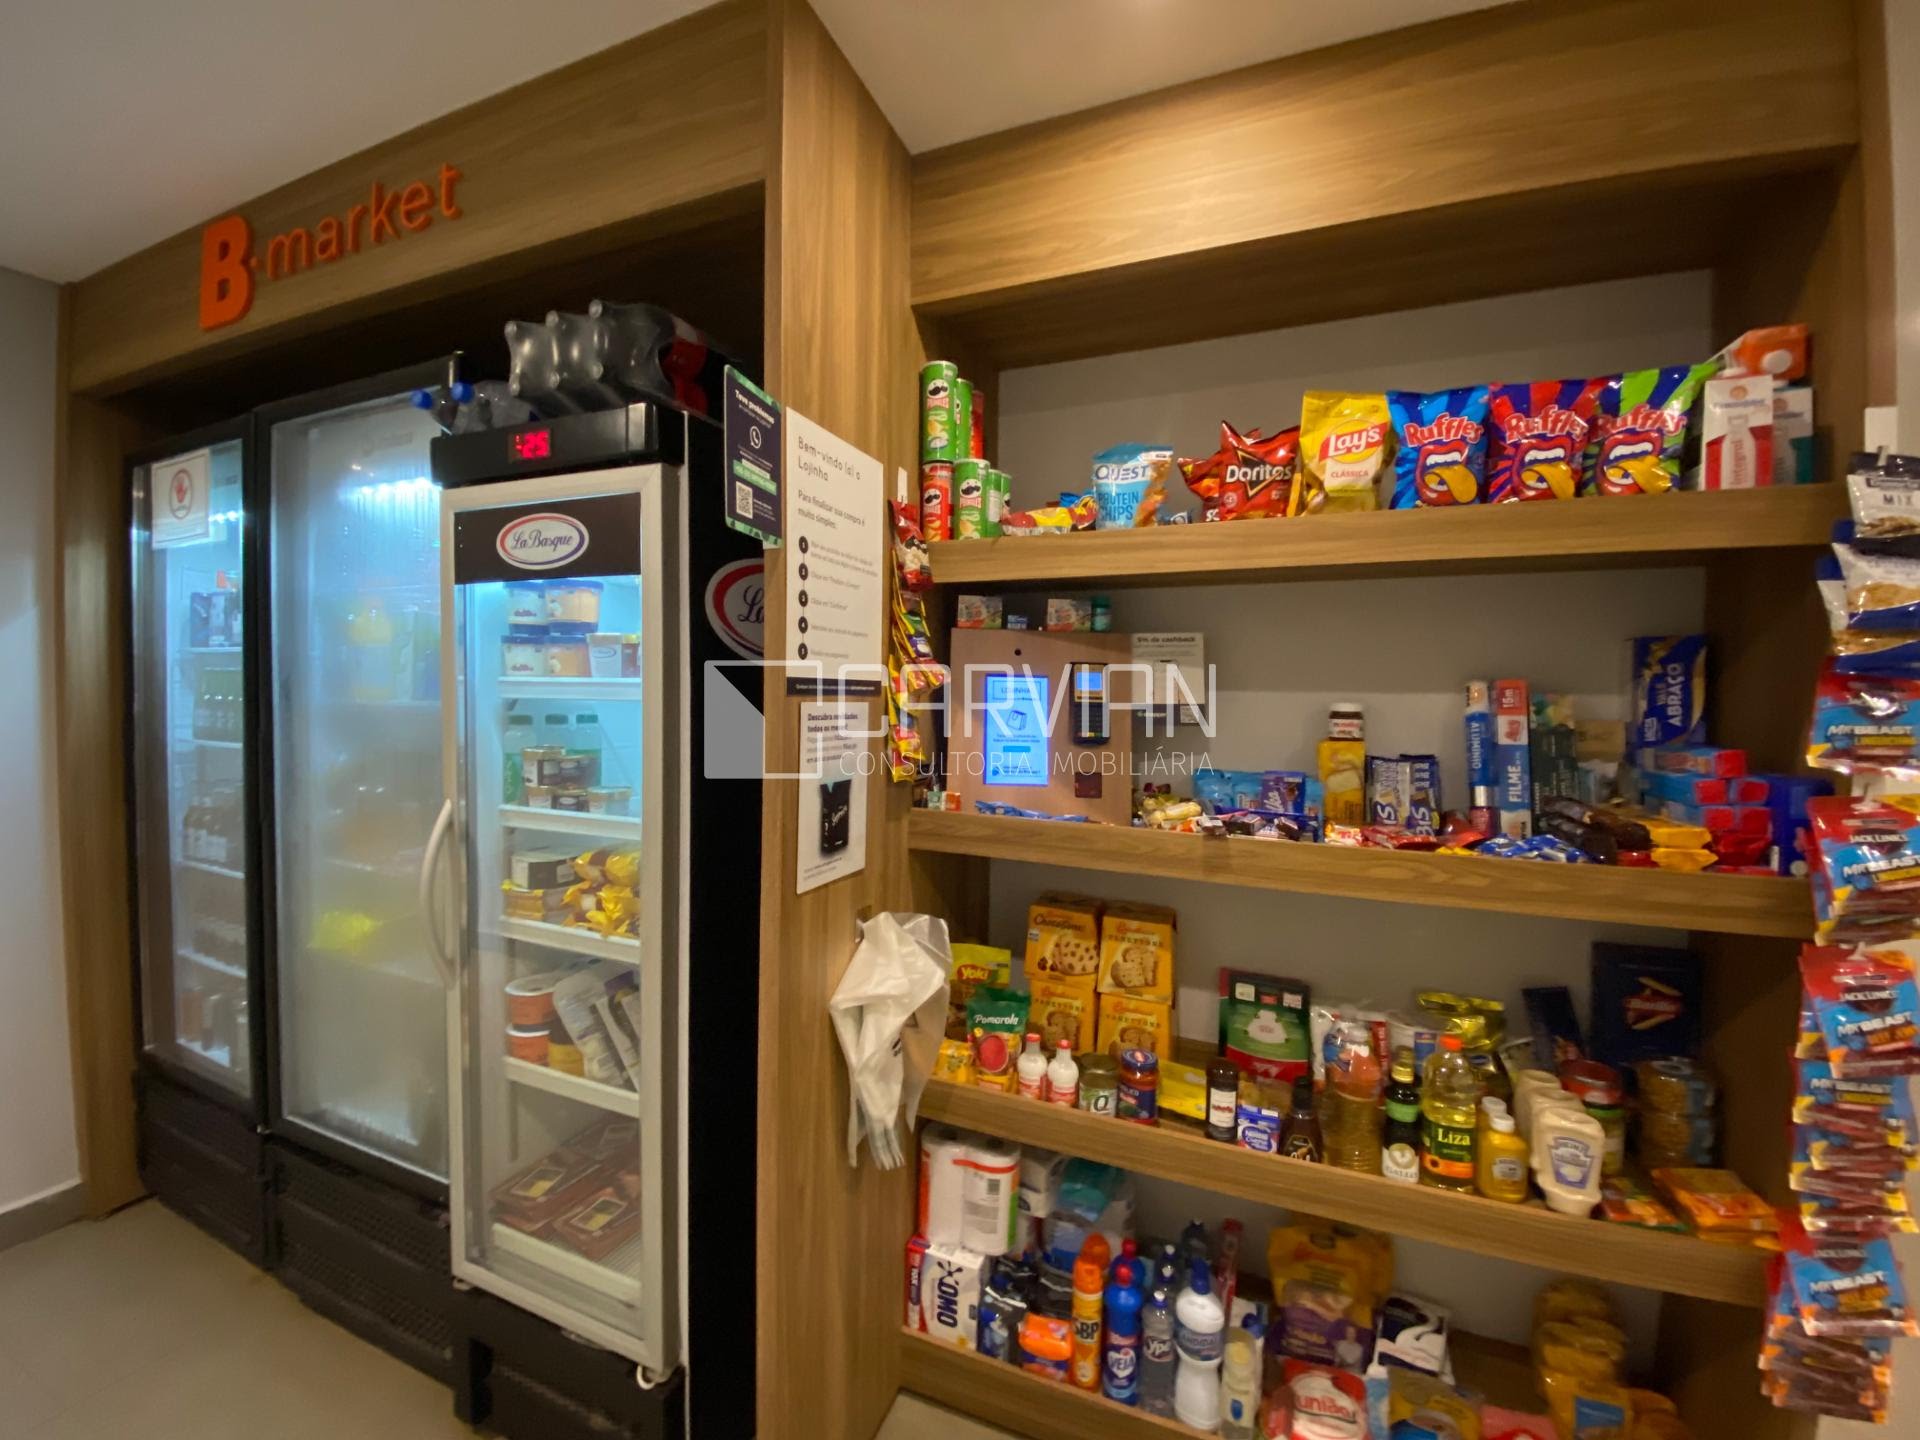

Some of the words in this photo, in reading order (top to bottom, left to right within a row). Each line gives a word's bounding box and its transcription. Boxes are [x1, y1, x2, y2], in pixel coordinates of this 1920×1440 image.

[267, 162, 462, 280] market
[1404, 412, 1484, 447] Ruffles
[1505, 404, 1589, 440] Ruffles
[1328, 426, 1381, 457] Lay's
[798, 455, 829, 481] Lojinha
[1095, 464, 1149, 481] QUEST
[1225, 464, 1292, 483] Doritos
[1098, 491, 1139, 505] PROTEIN
[511, 530, 528, 550] La
[528, 529, 573, 552] Basque
[1667, 663, 1685, 727] ABRAÇO
[1508, 765, 1521, 802] FILME
[974, 1013, 1019, 1025] Pomarola
[1438, 1128, 1471, 1146] Liza
[937, 1278, 958, 1328] OMO
